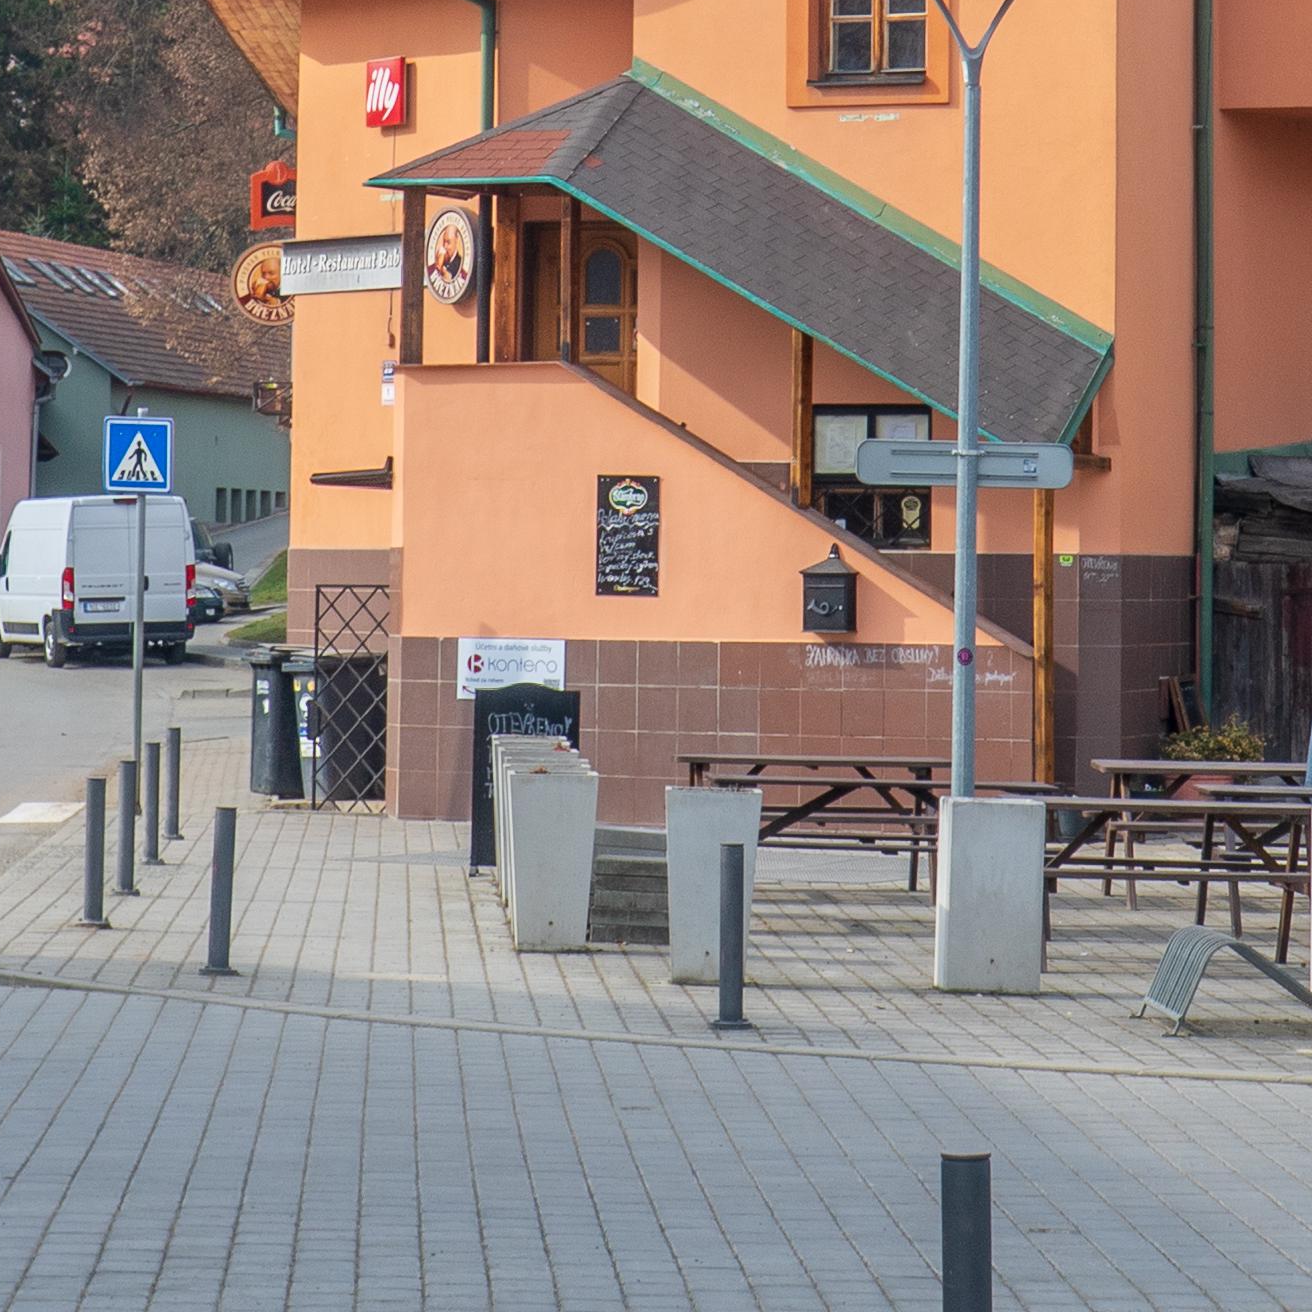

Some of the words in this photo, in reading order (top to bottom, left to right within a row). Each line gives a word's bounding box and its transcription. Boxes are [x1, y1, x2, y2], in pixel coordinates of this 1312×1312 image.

[367, 67, 400, 122] illy
[282, 254, 311, 276] Hotel
[320, 252, 377, 272] Restaurant
